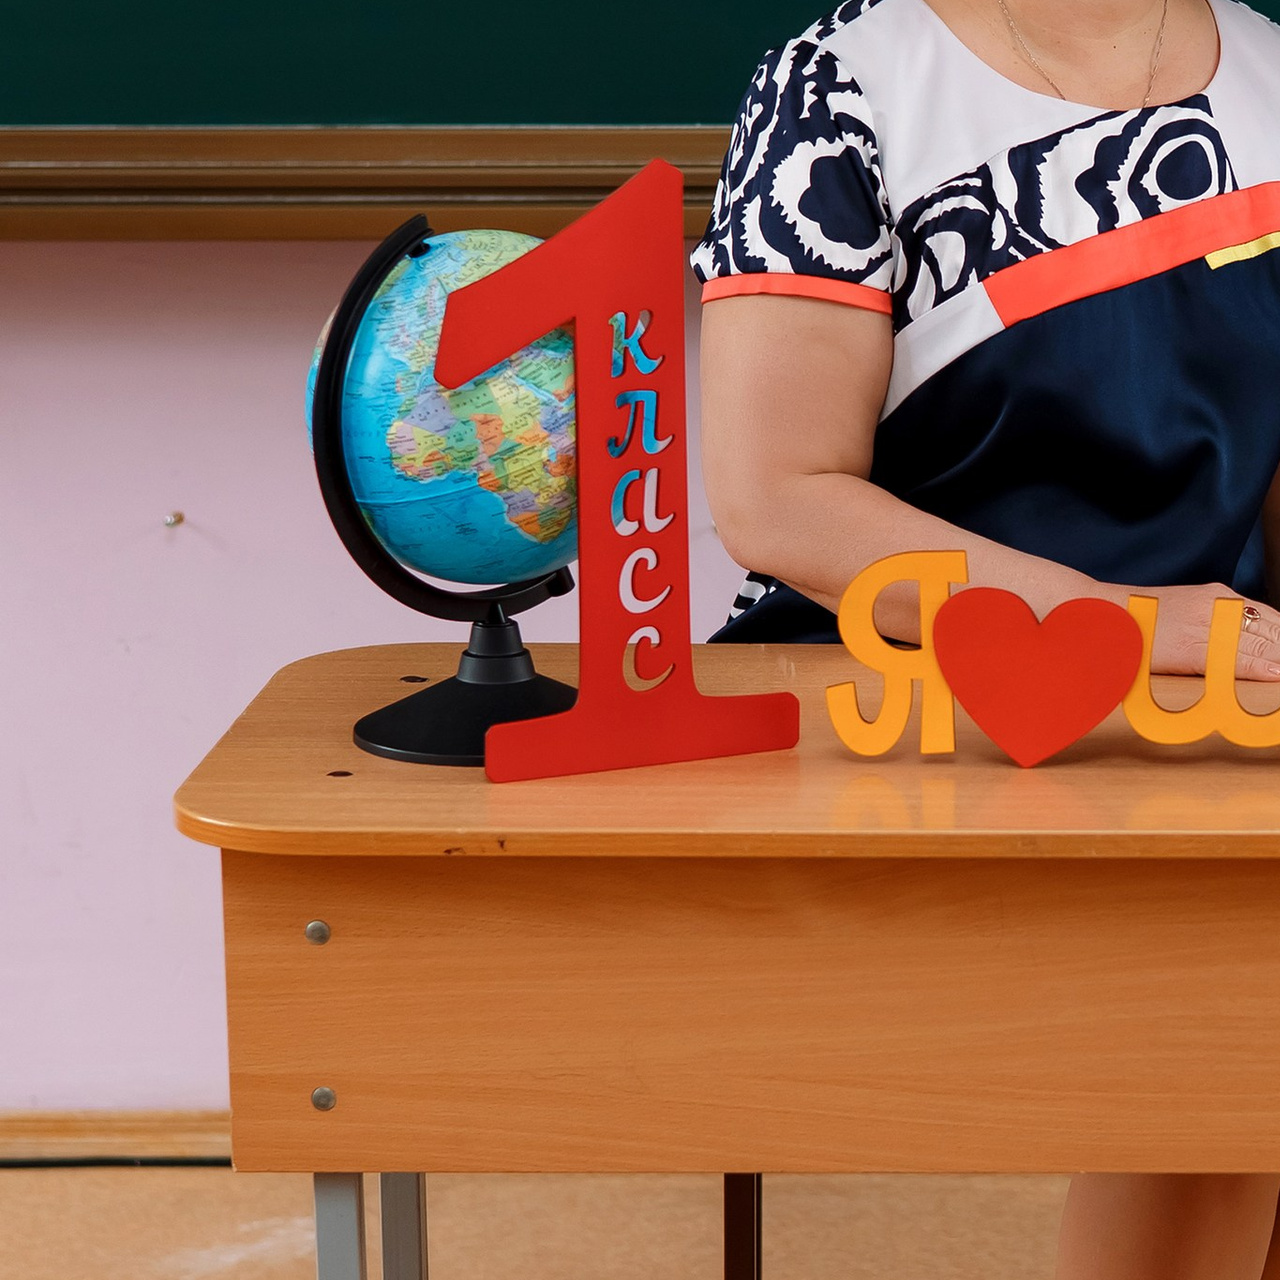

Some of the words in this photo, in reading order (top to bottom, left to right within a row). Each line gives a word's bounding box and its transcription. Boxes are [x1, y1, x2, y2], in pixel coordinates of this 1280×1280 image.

[434, 158, 799, 783] 1
[606, 308, 676, 693] класс
[825, 550, 968, 756] Я
